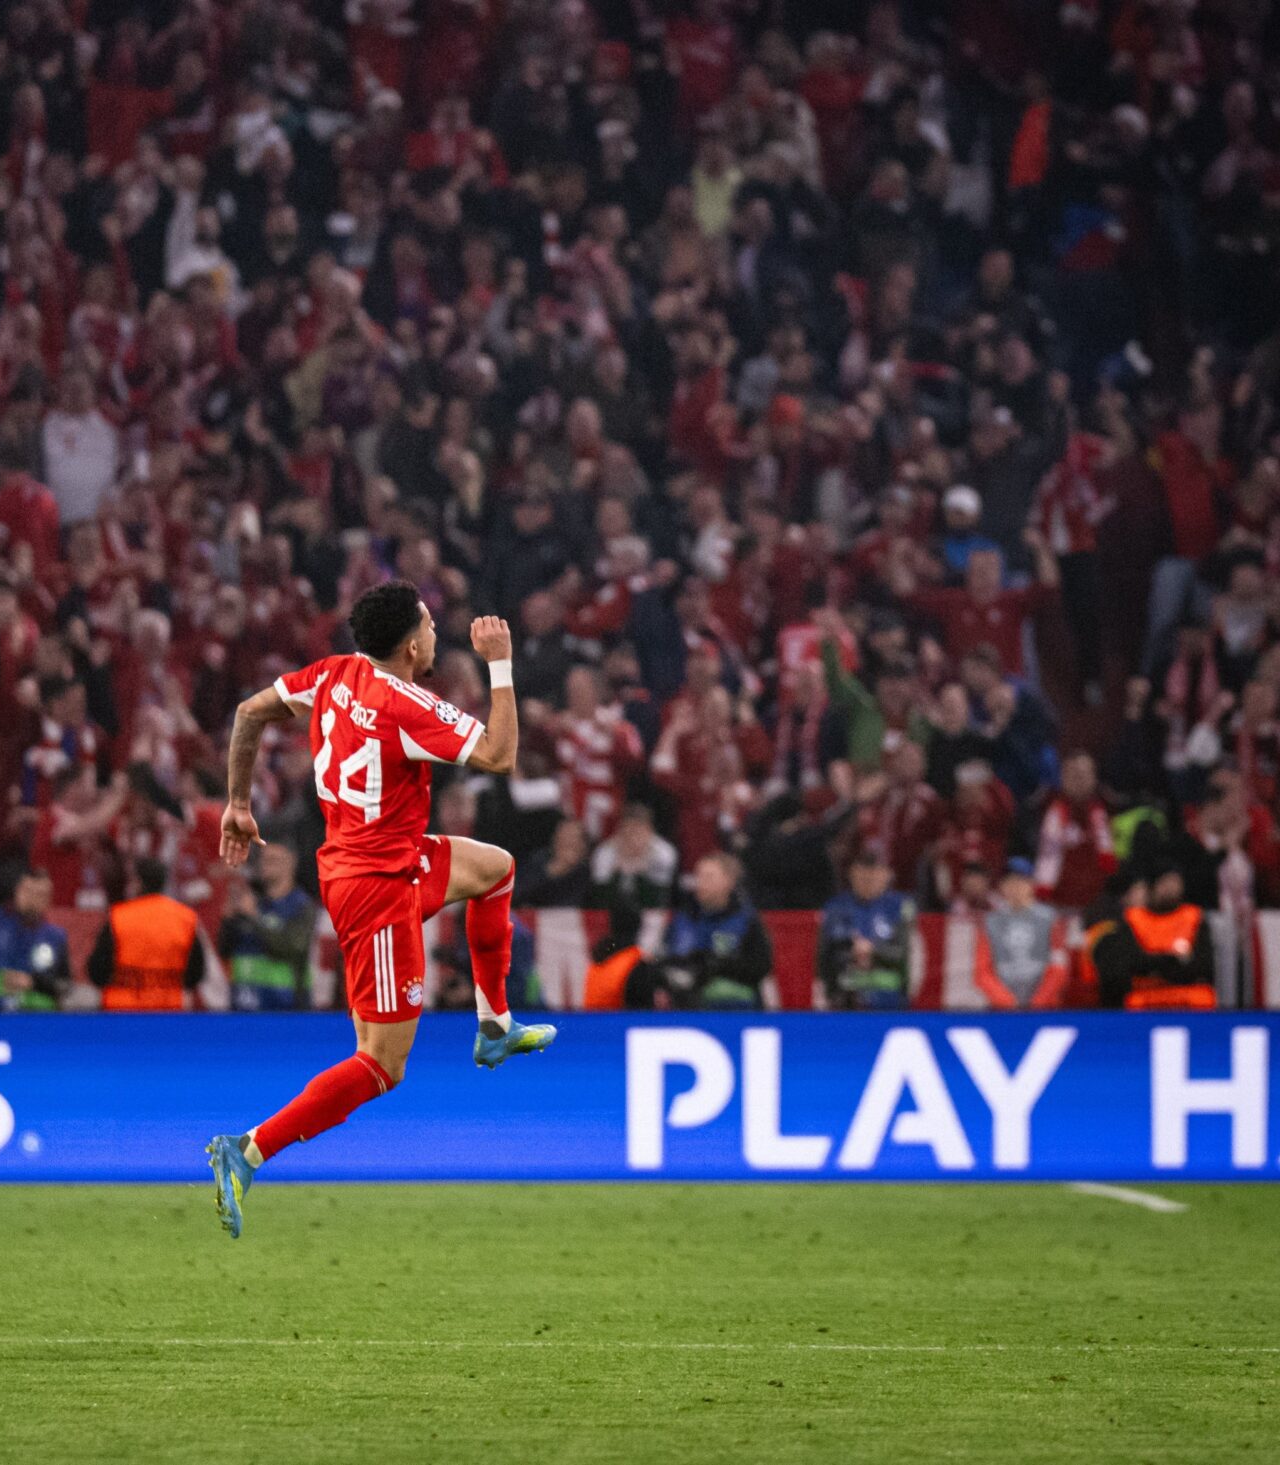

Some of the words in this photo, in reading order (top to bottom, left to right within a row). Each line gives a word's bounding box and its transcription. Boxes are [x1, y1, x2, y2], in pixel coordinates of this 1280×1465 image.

[314, 708, 382, 824] 14
[625, 1026, 1078, 1171] PLAY
[1150, 1026, 1280, 1171] H
